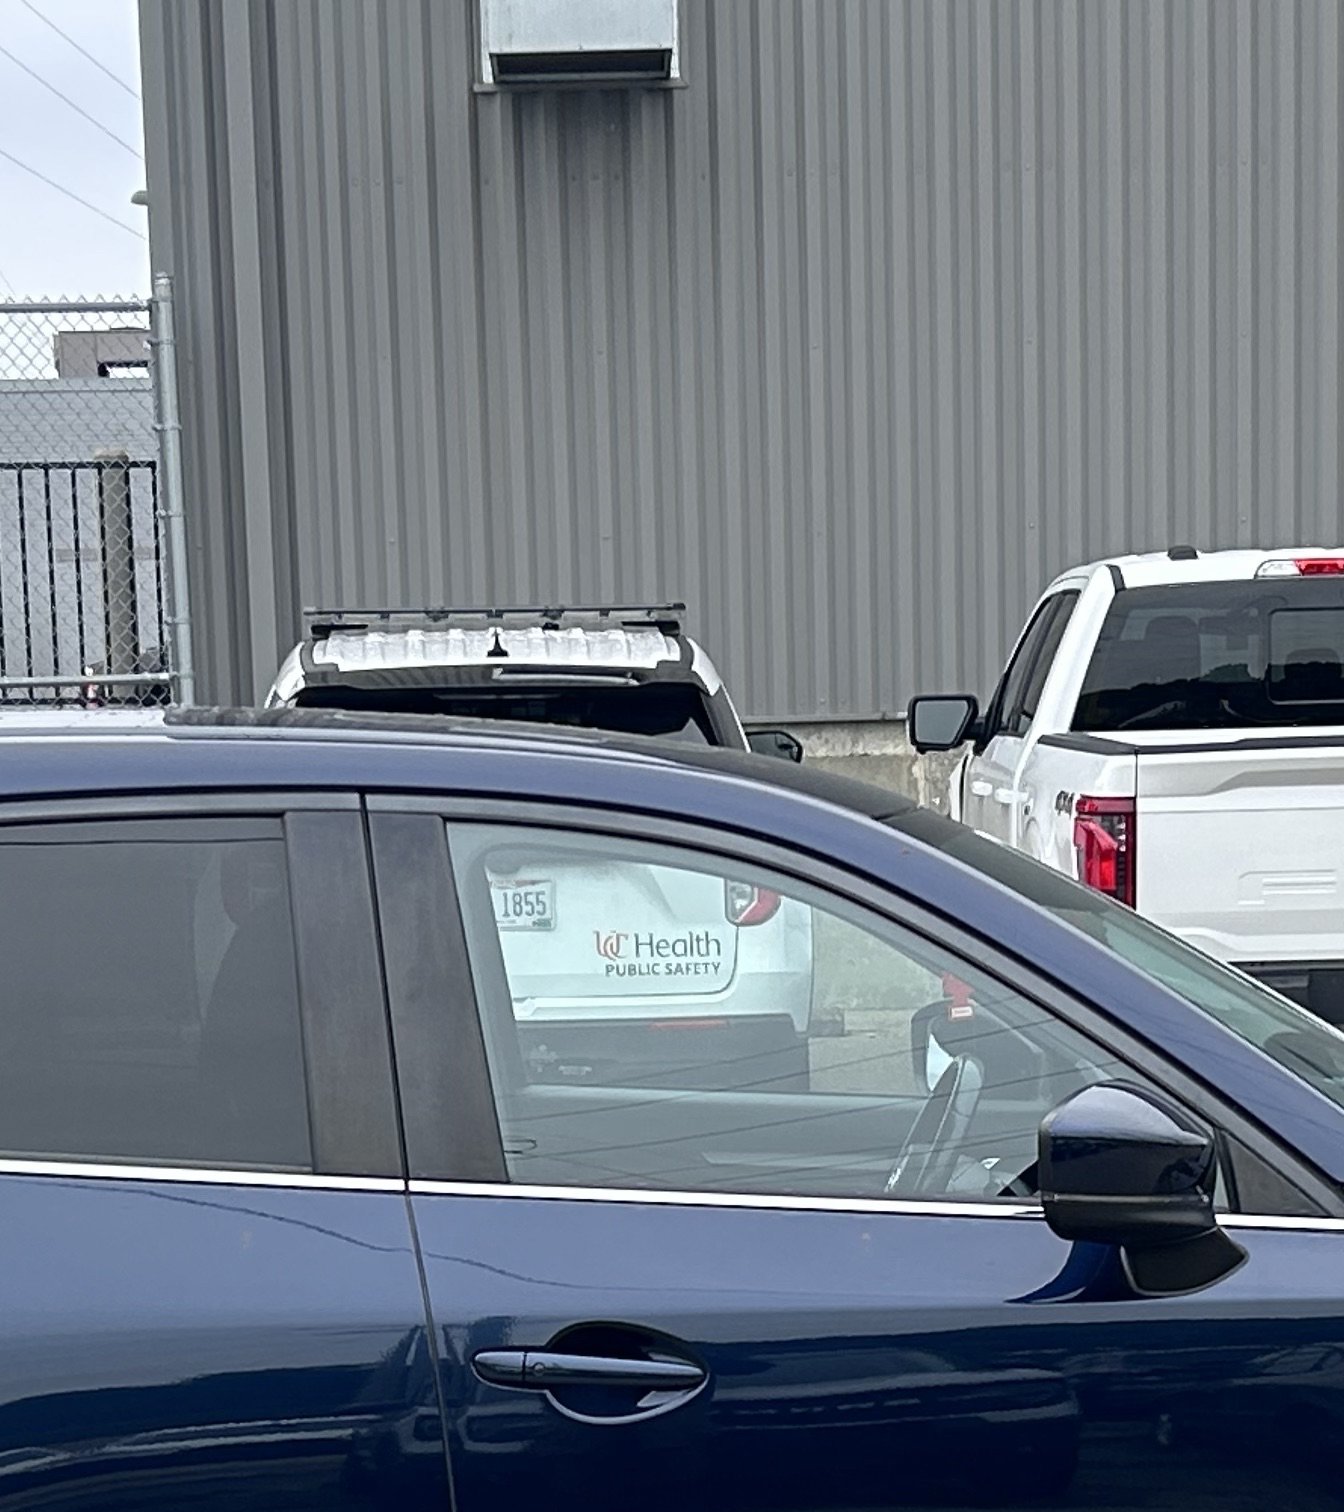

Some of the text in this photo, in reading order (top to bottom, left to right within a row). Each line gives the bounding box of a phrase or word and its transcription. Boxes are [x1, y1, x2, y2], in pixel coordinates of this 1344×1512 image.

[502, 890, 547, 918] 1855
[634, 930, 723, 958] Health
[605, 961, 722, 977] PUBLIC SAFETY
